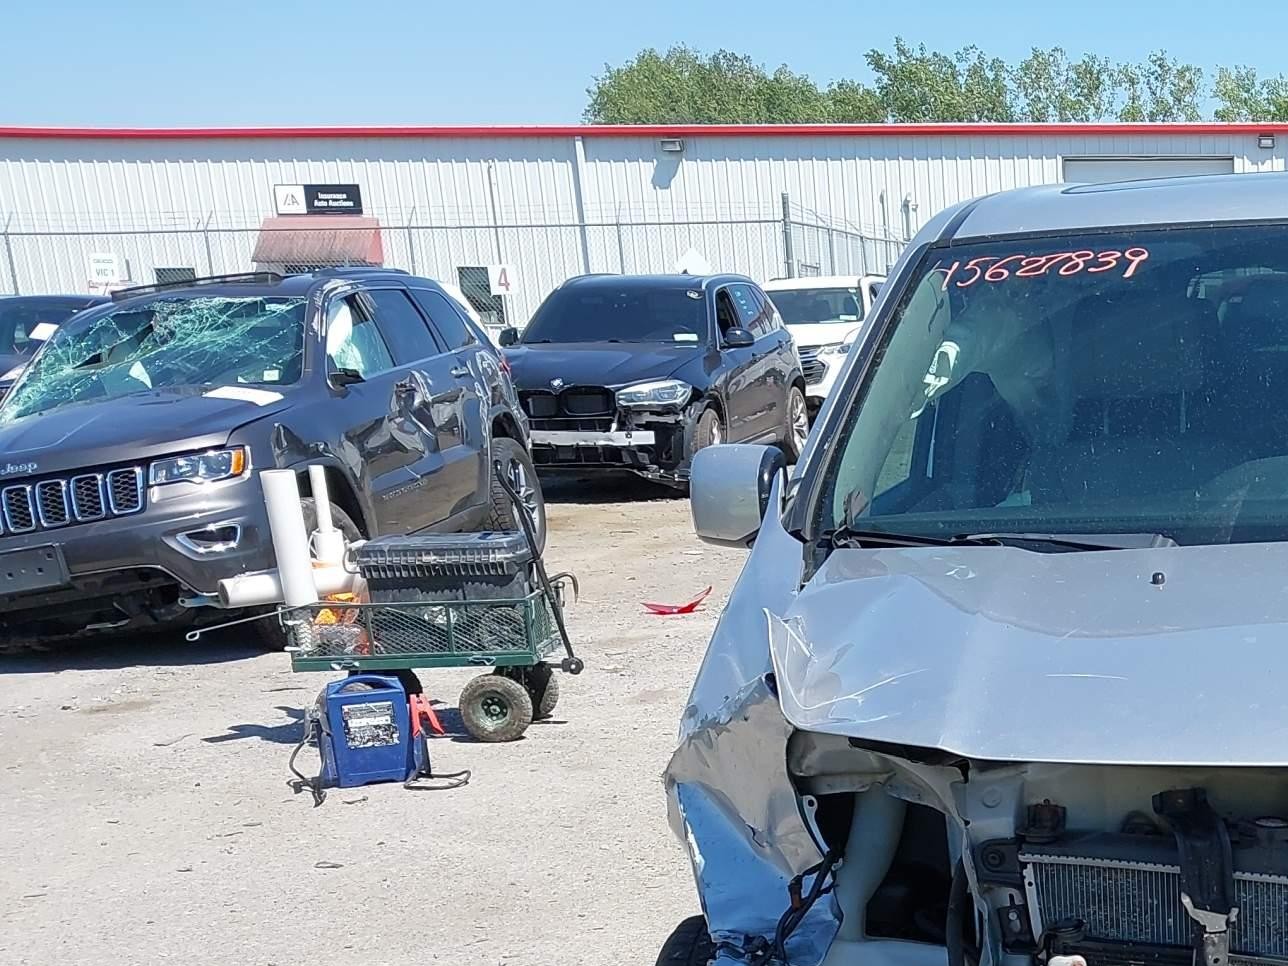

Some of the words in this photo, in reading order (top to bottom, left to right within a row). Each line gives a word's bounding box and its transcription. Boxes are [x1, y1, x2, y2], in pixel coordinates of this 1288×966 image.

[313, 199, 328, 207] Auto
[931, 247, 1149, 291] 45627839
[498, 267, 511, 291] 4
[0, 462, 38, 476] Jeep
